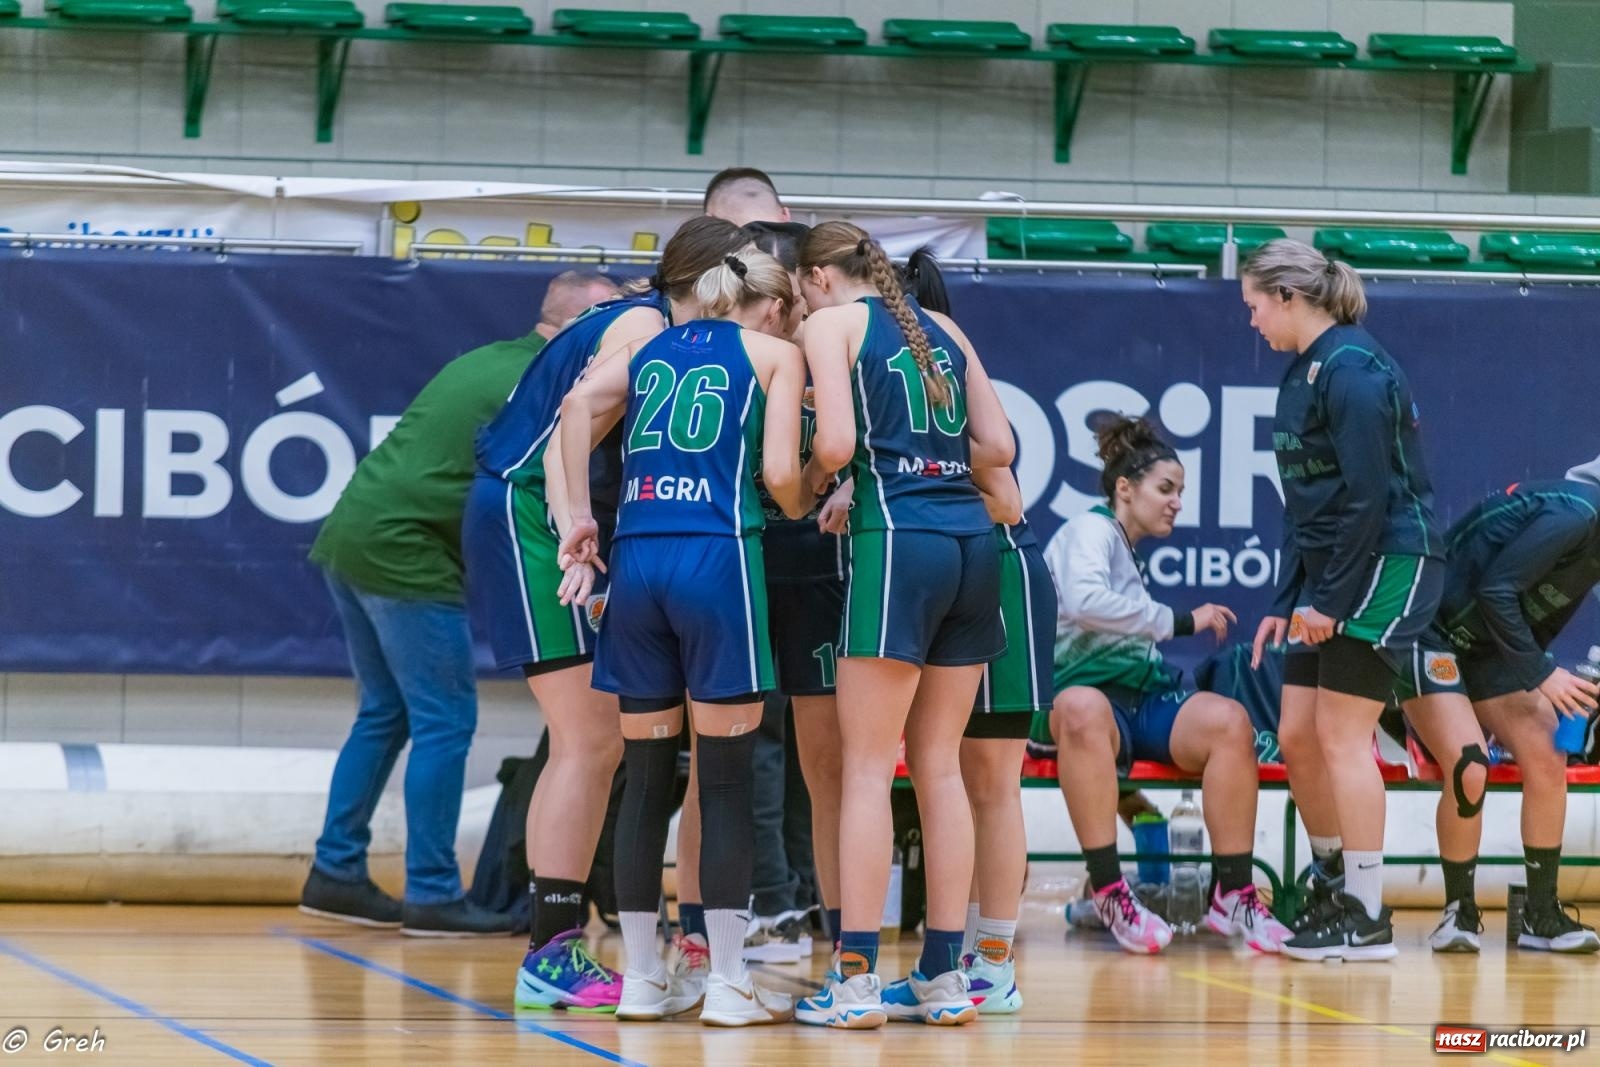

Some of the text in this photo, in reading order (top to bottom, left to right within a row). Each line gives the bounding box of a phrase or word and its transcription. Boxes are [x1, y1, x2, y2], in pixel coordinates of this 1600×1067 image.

[628, 359, 730, 454] 26
[0, 371, 404, 524] CIBÓ
[1139, 534, 1281, 588] CIBÓ
[812, 642, 839, 687] 1
